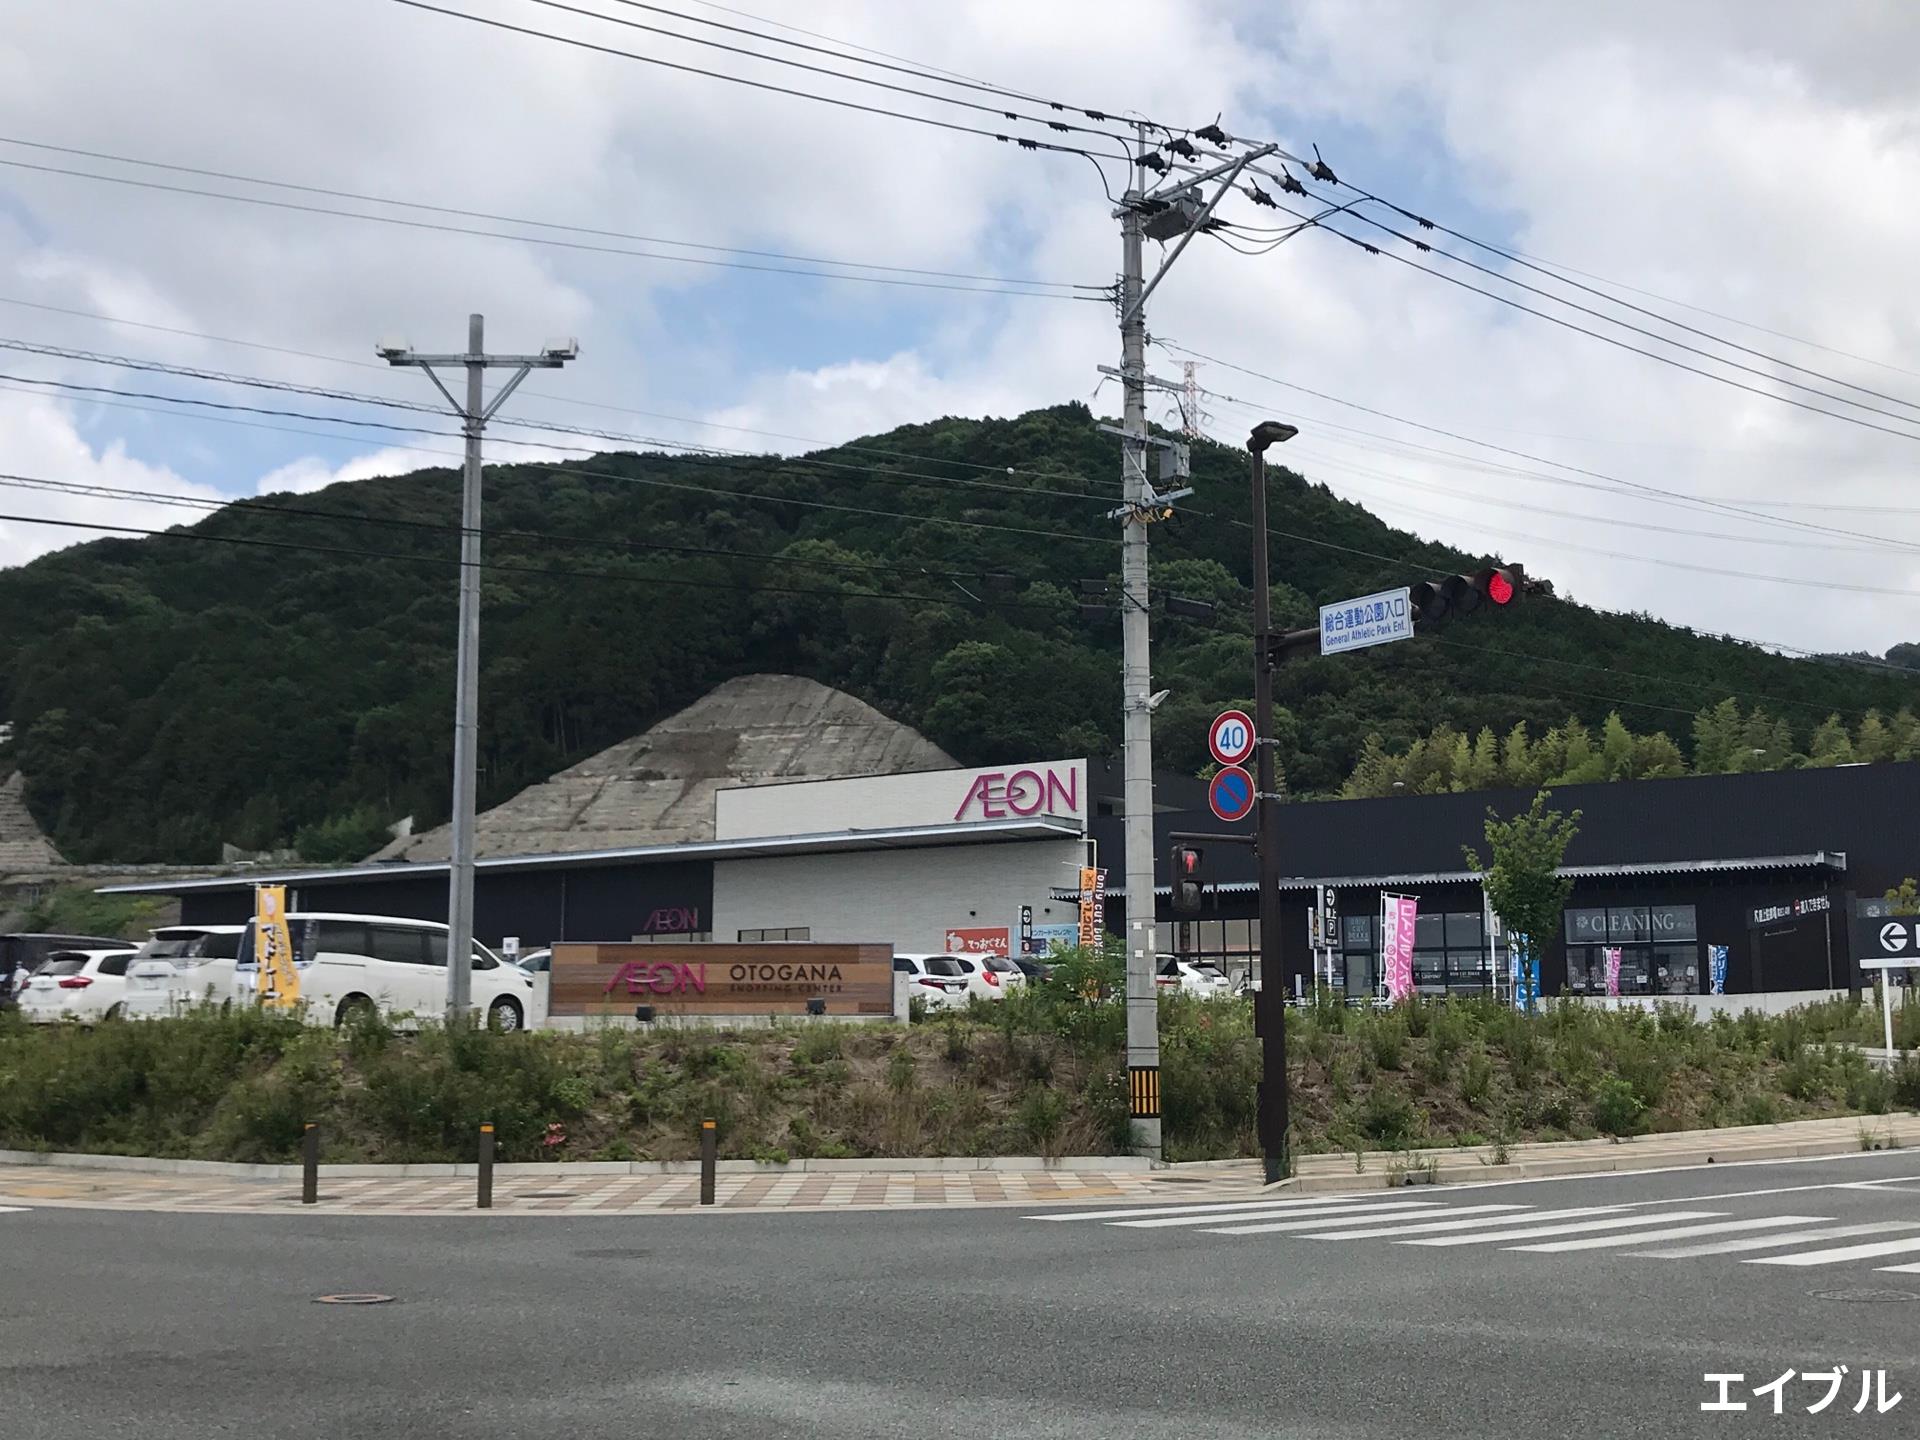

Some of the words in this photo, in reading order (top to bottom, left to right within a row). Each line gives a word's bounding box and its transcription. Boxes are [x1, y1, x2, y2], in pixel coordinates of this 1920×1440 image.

[1325, 598, 1404, 633] 総合運動公園入口
[1326, 634, 1350, 646] General
[1352, 628, 1375, 640] Athletic
[1377, 624, 1391, 636] Park
[1393, 620, 1407, 633] Ent.
[1220, 726, 1244, 750] 40
[1095, 873, 1106, 900] only
[1094, 903, 1103, 923] cut
[1591, 913, 1674, 932] CLEANING
[730, 964, 842, 981] OTOGANA
[798, 984, 842, 993] CENTER
